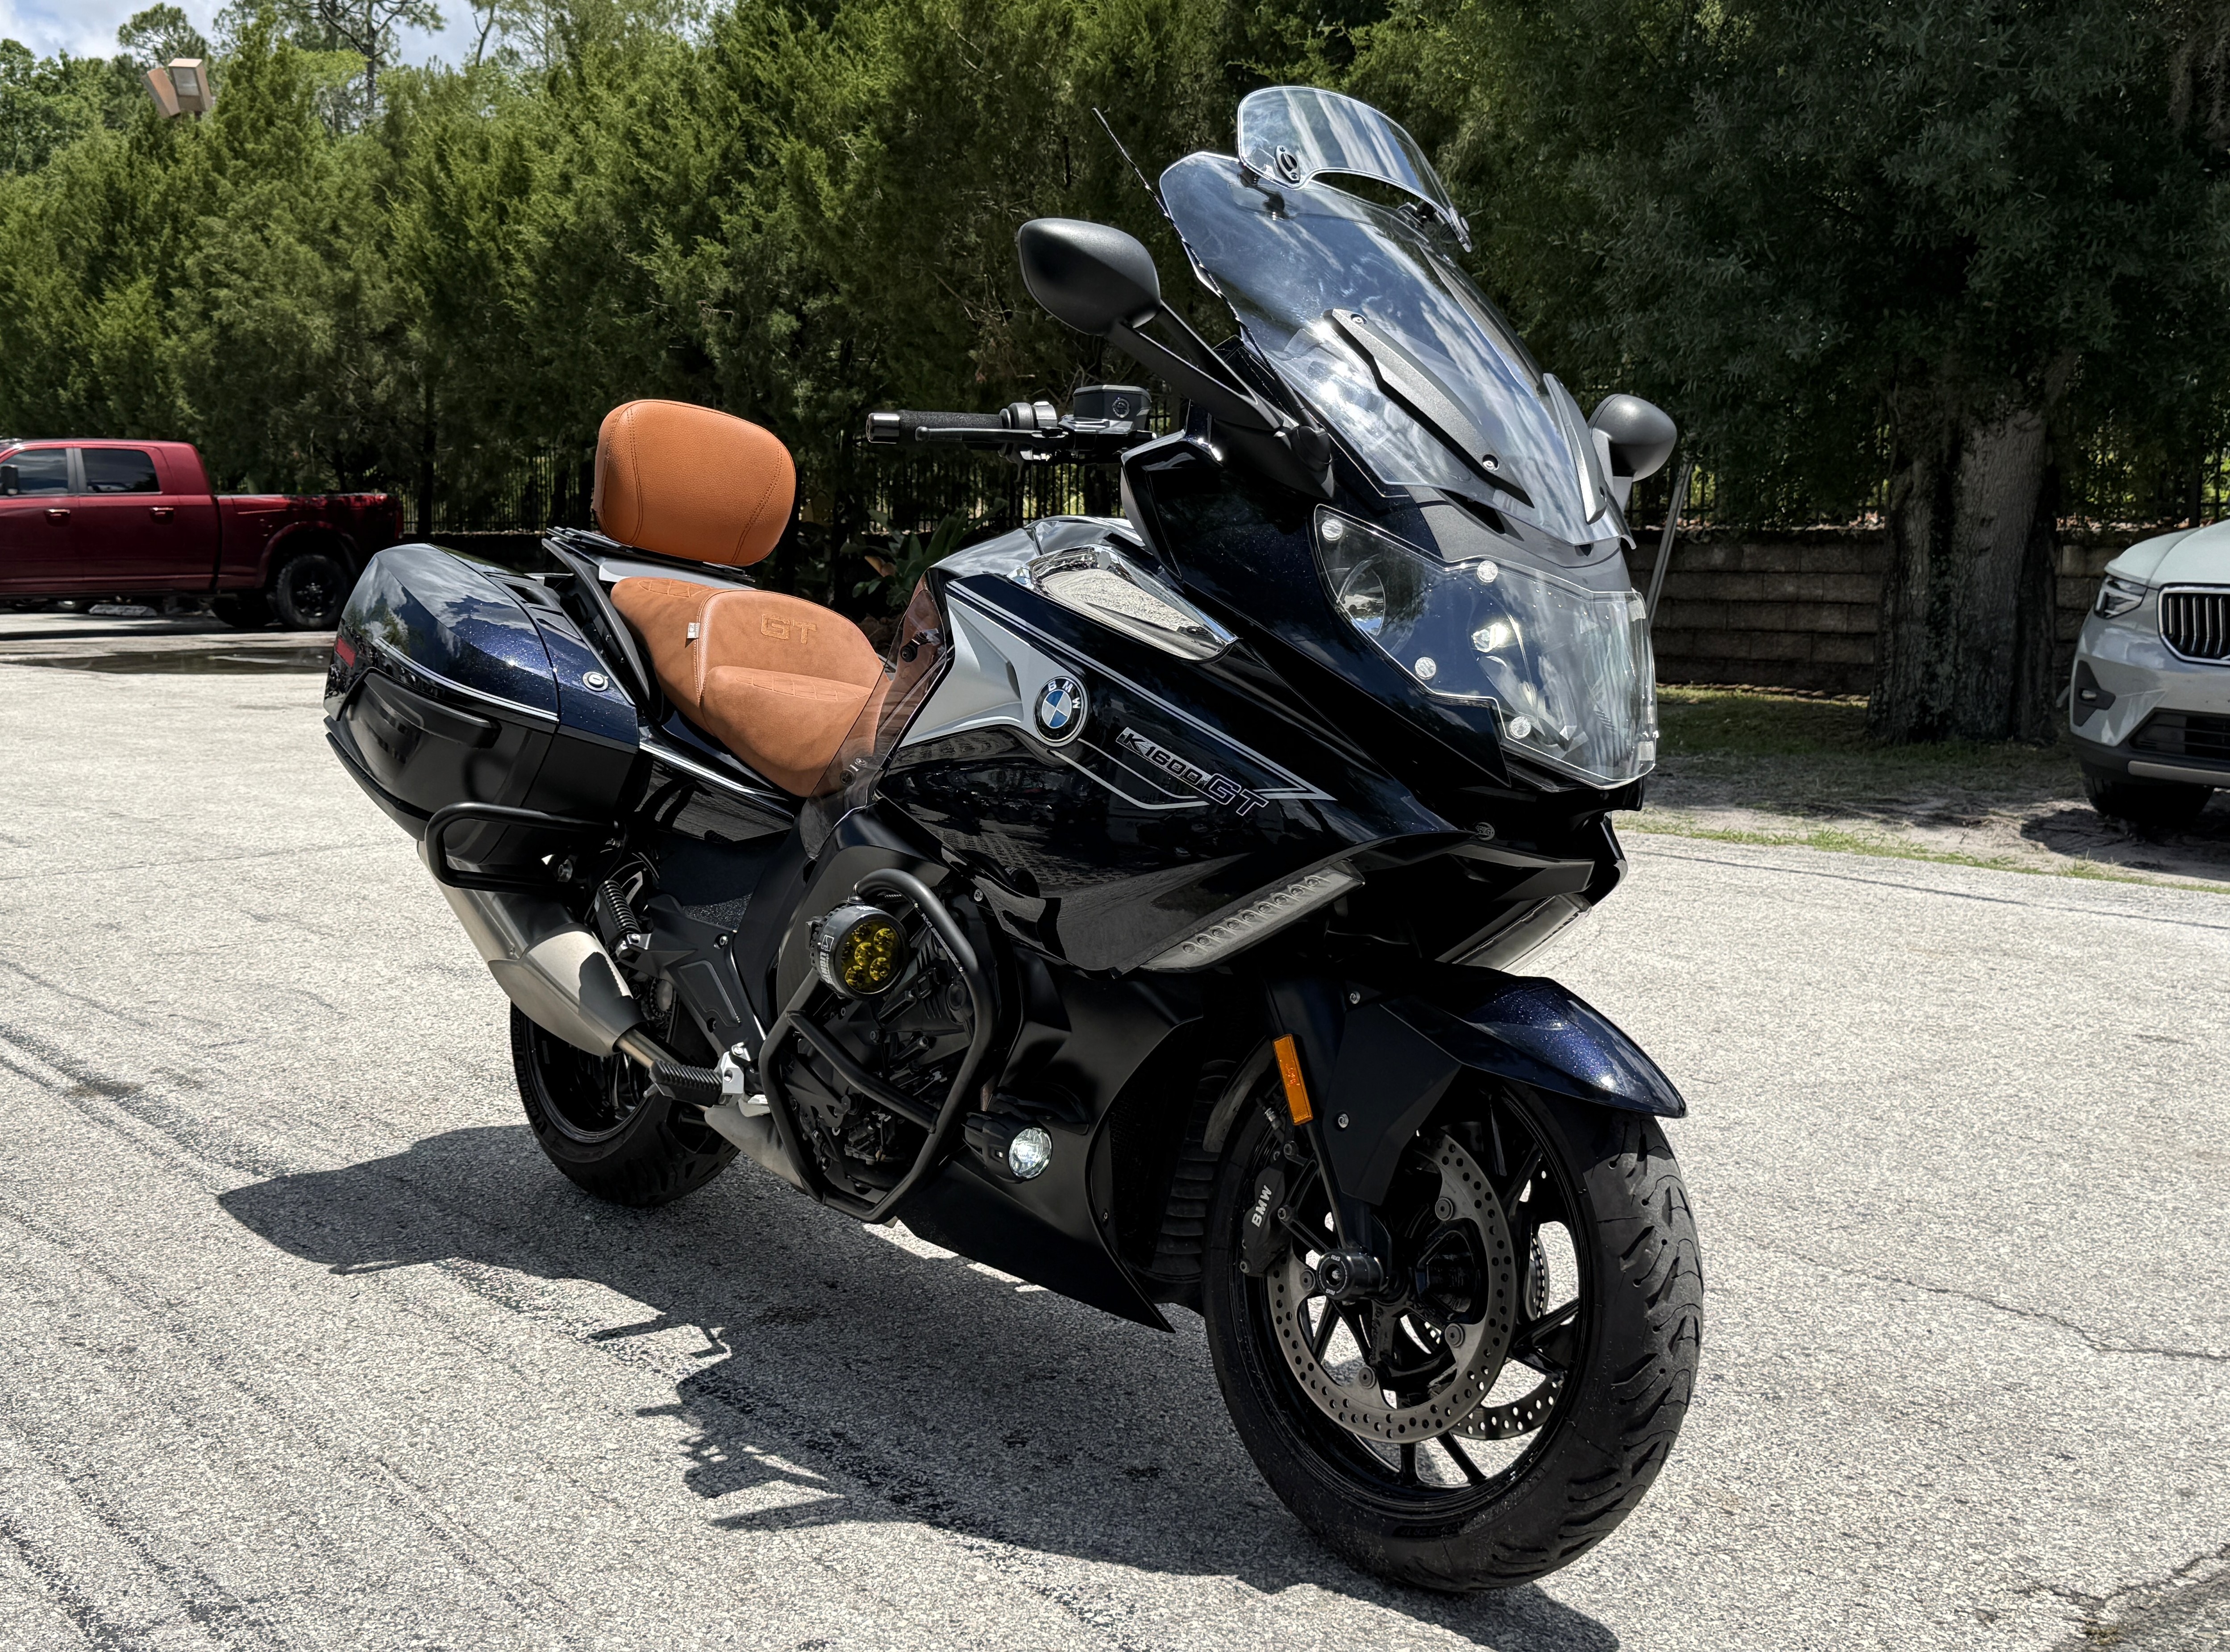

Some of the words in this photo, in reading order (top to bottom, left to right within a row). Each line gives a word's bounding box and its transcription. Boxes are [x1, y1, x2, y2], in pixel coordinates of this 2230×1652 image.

[761, 614, 817, 644] GT
[1048, 680, 1081, 709] BMW
[1204, 773, 1269, 816] GT
[512, 1007, 522, 1050] 190/5
[516, 1059, 539, 1117] MICHELIN
[1251, 1184, 1272, 1228] BMW
